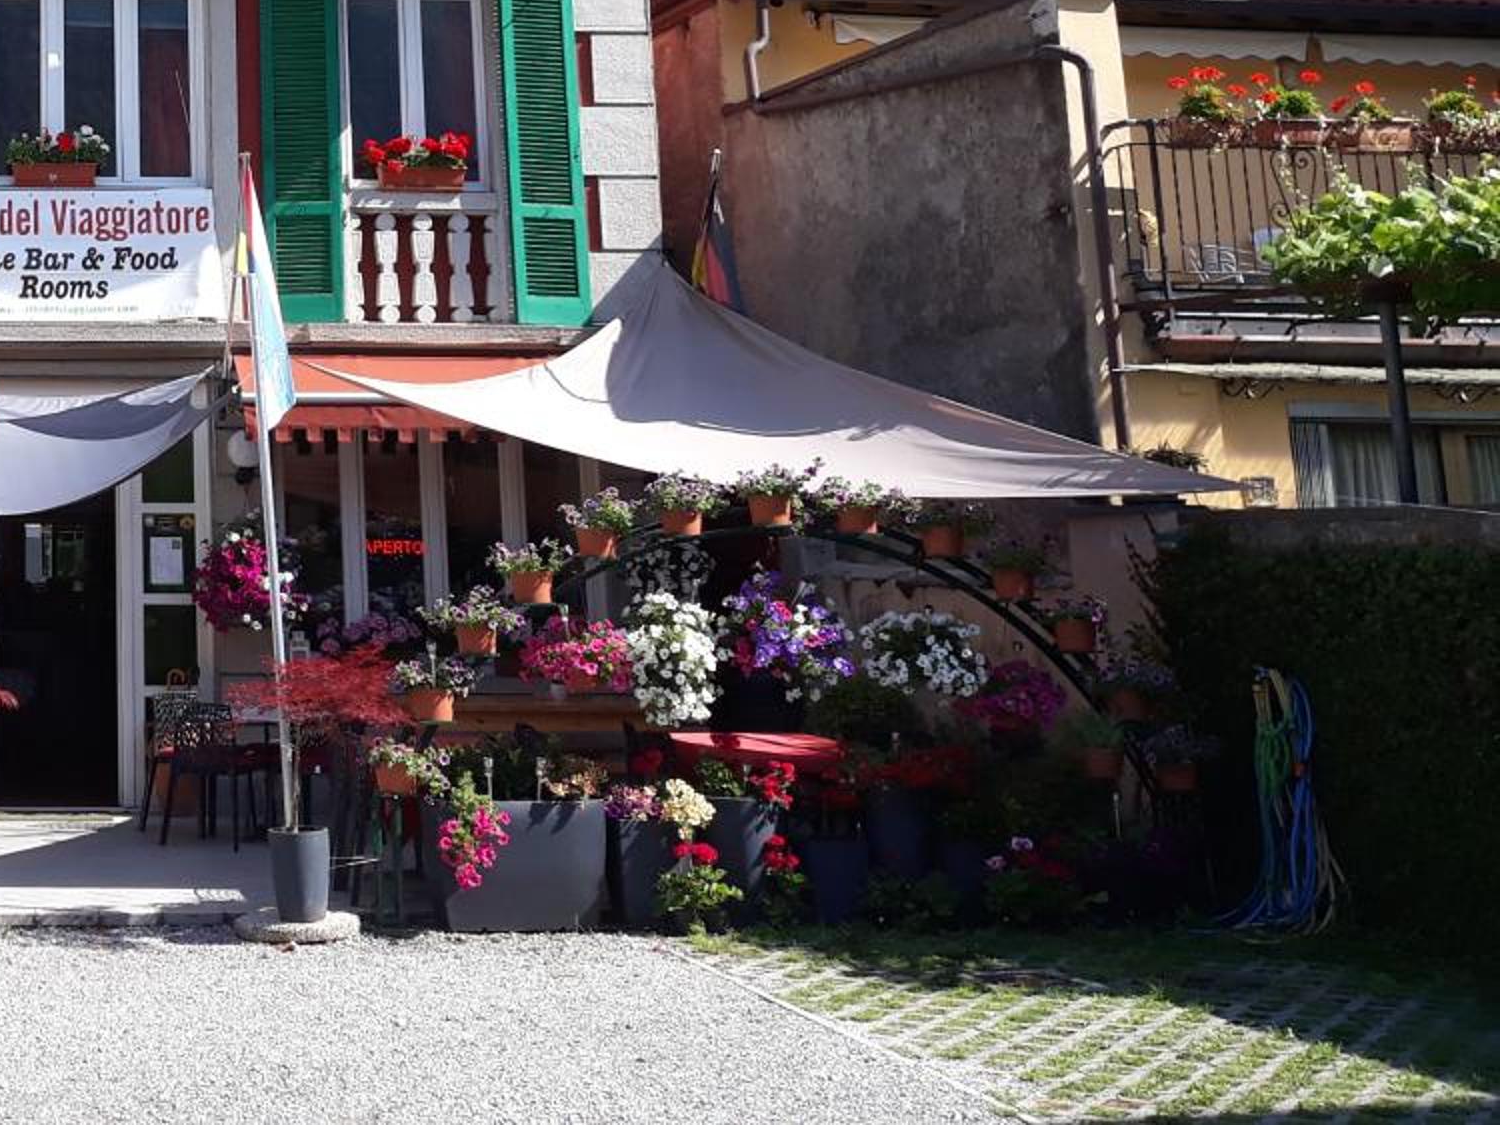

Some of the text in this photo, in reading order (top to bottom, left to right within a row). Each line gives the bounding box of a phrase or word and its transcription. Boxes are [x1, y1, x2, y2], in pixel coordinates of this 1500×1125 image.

[0, 198, 39, 236] del
[50, 198, 209, 242] Viaggiatore
[23, 248, 75, 271] Bar
[81, 246, 105, 271] &
[112, 246, 179, 271] Food
[18, 275, 109, 300] Rooms
